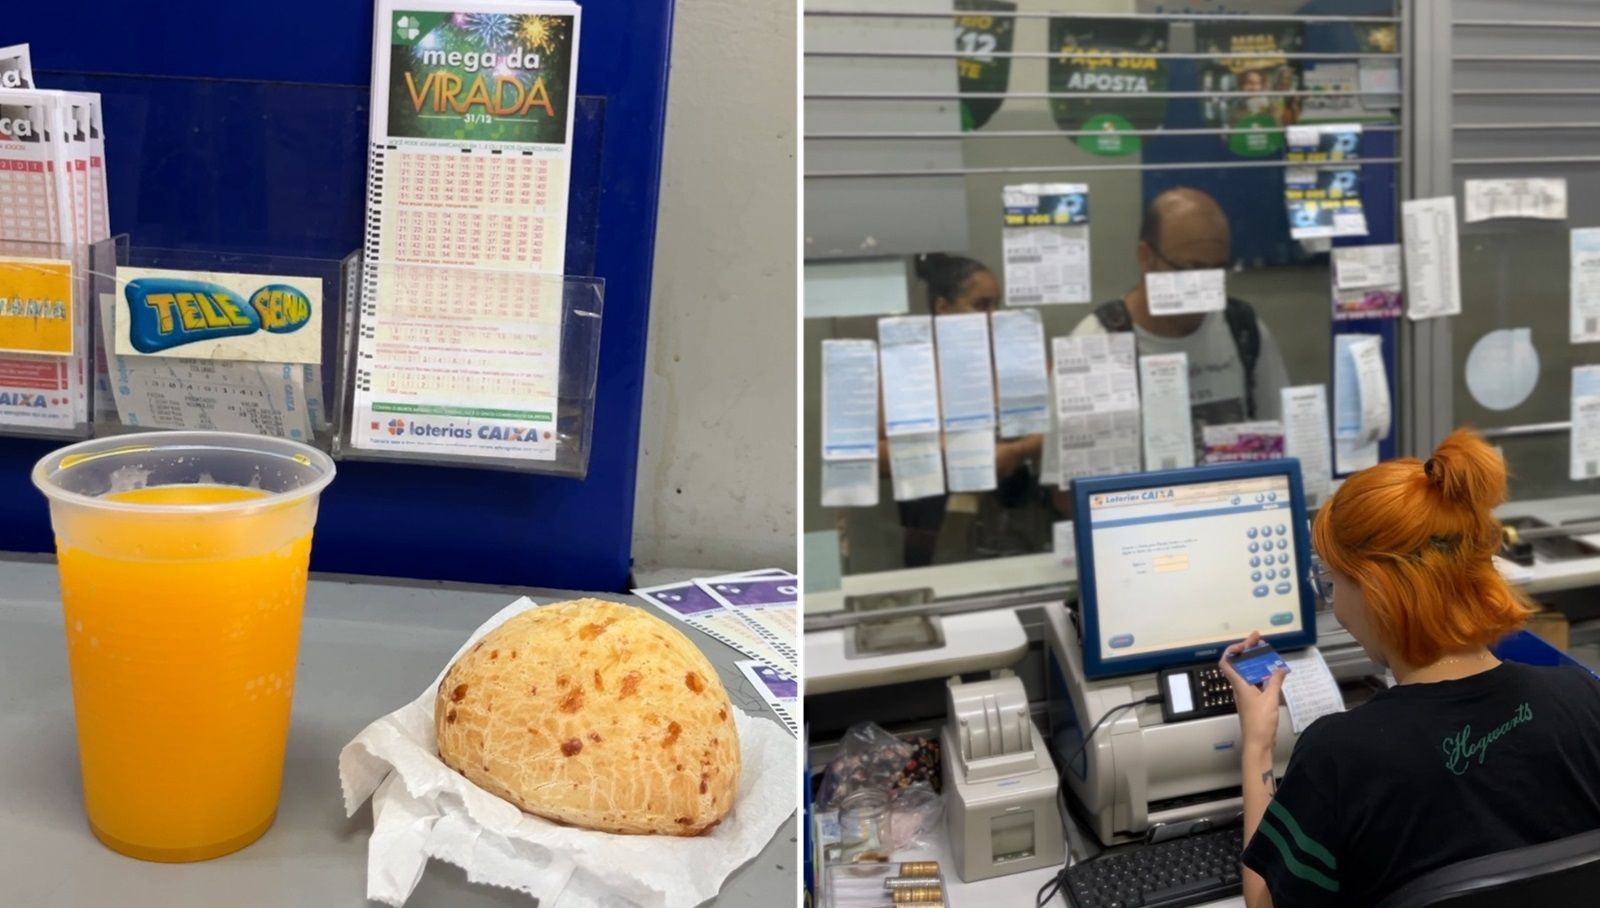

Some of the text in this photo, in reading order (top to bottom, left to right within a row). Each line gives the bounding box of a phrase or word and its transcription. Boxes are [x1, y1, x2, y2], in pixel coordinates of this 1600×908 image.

[423, 47, 540, 72] mega da
[1059, 46, 1158, 70] FAÇA SUA
[404, 72, 555, 117] VIRADA
[1068, 73, 1149, 92] APOSTA
[464, 113, 493, 124] 31/12
[146, 288, 308, 335] TELE SENA
[410, 422, 538, 442] loterias CAIXA
[1141, 490, 1174, 500] CAIXA
[1442, 702, 1533, 776] Hogwarts
